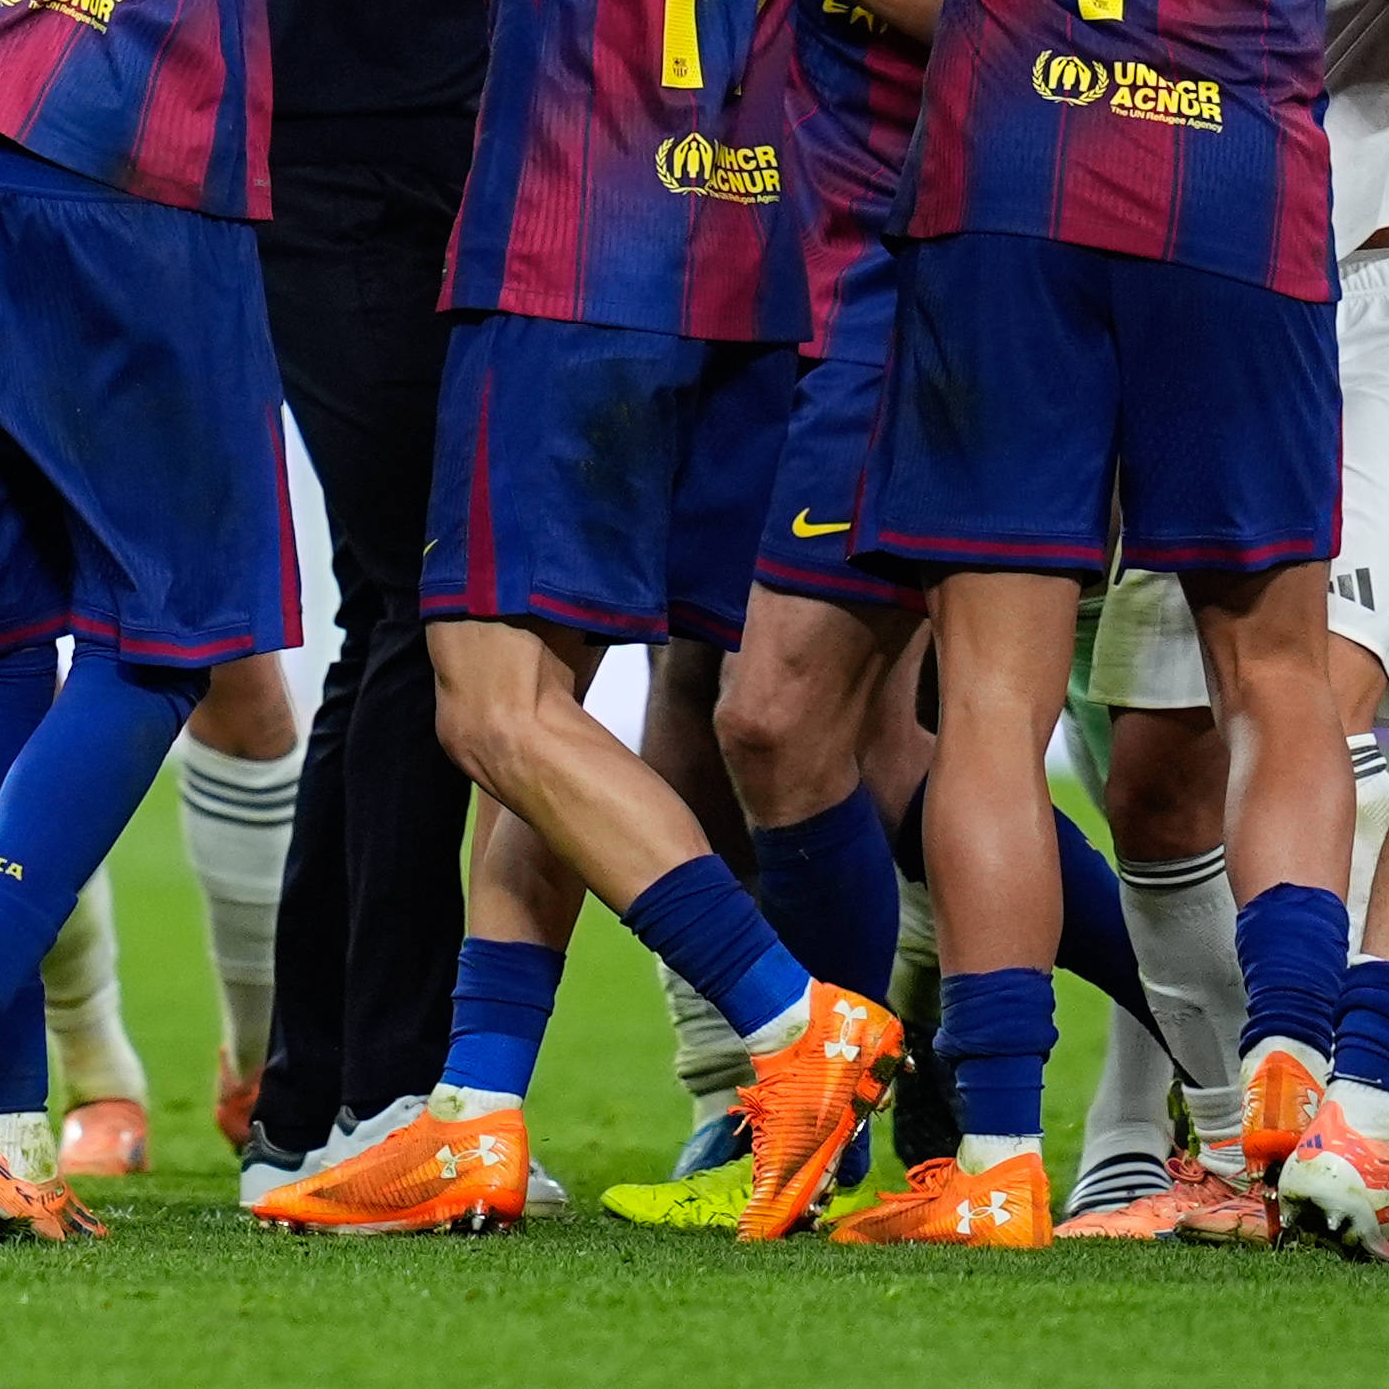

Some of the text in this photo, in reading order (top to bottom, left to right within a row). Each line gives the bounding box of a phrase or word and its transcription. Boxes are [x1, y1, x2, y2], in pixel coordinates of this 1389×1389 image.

[1110, 86, 1222, 122] ACNUR
[1111, 106, 1223, 133] The UN Refugee Agency
